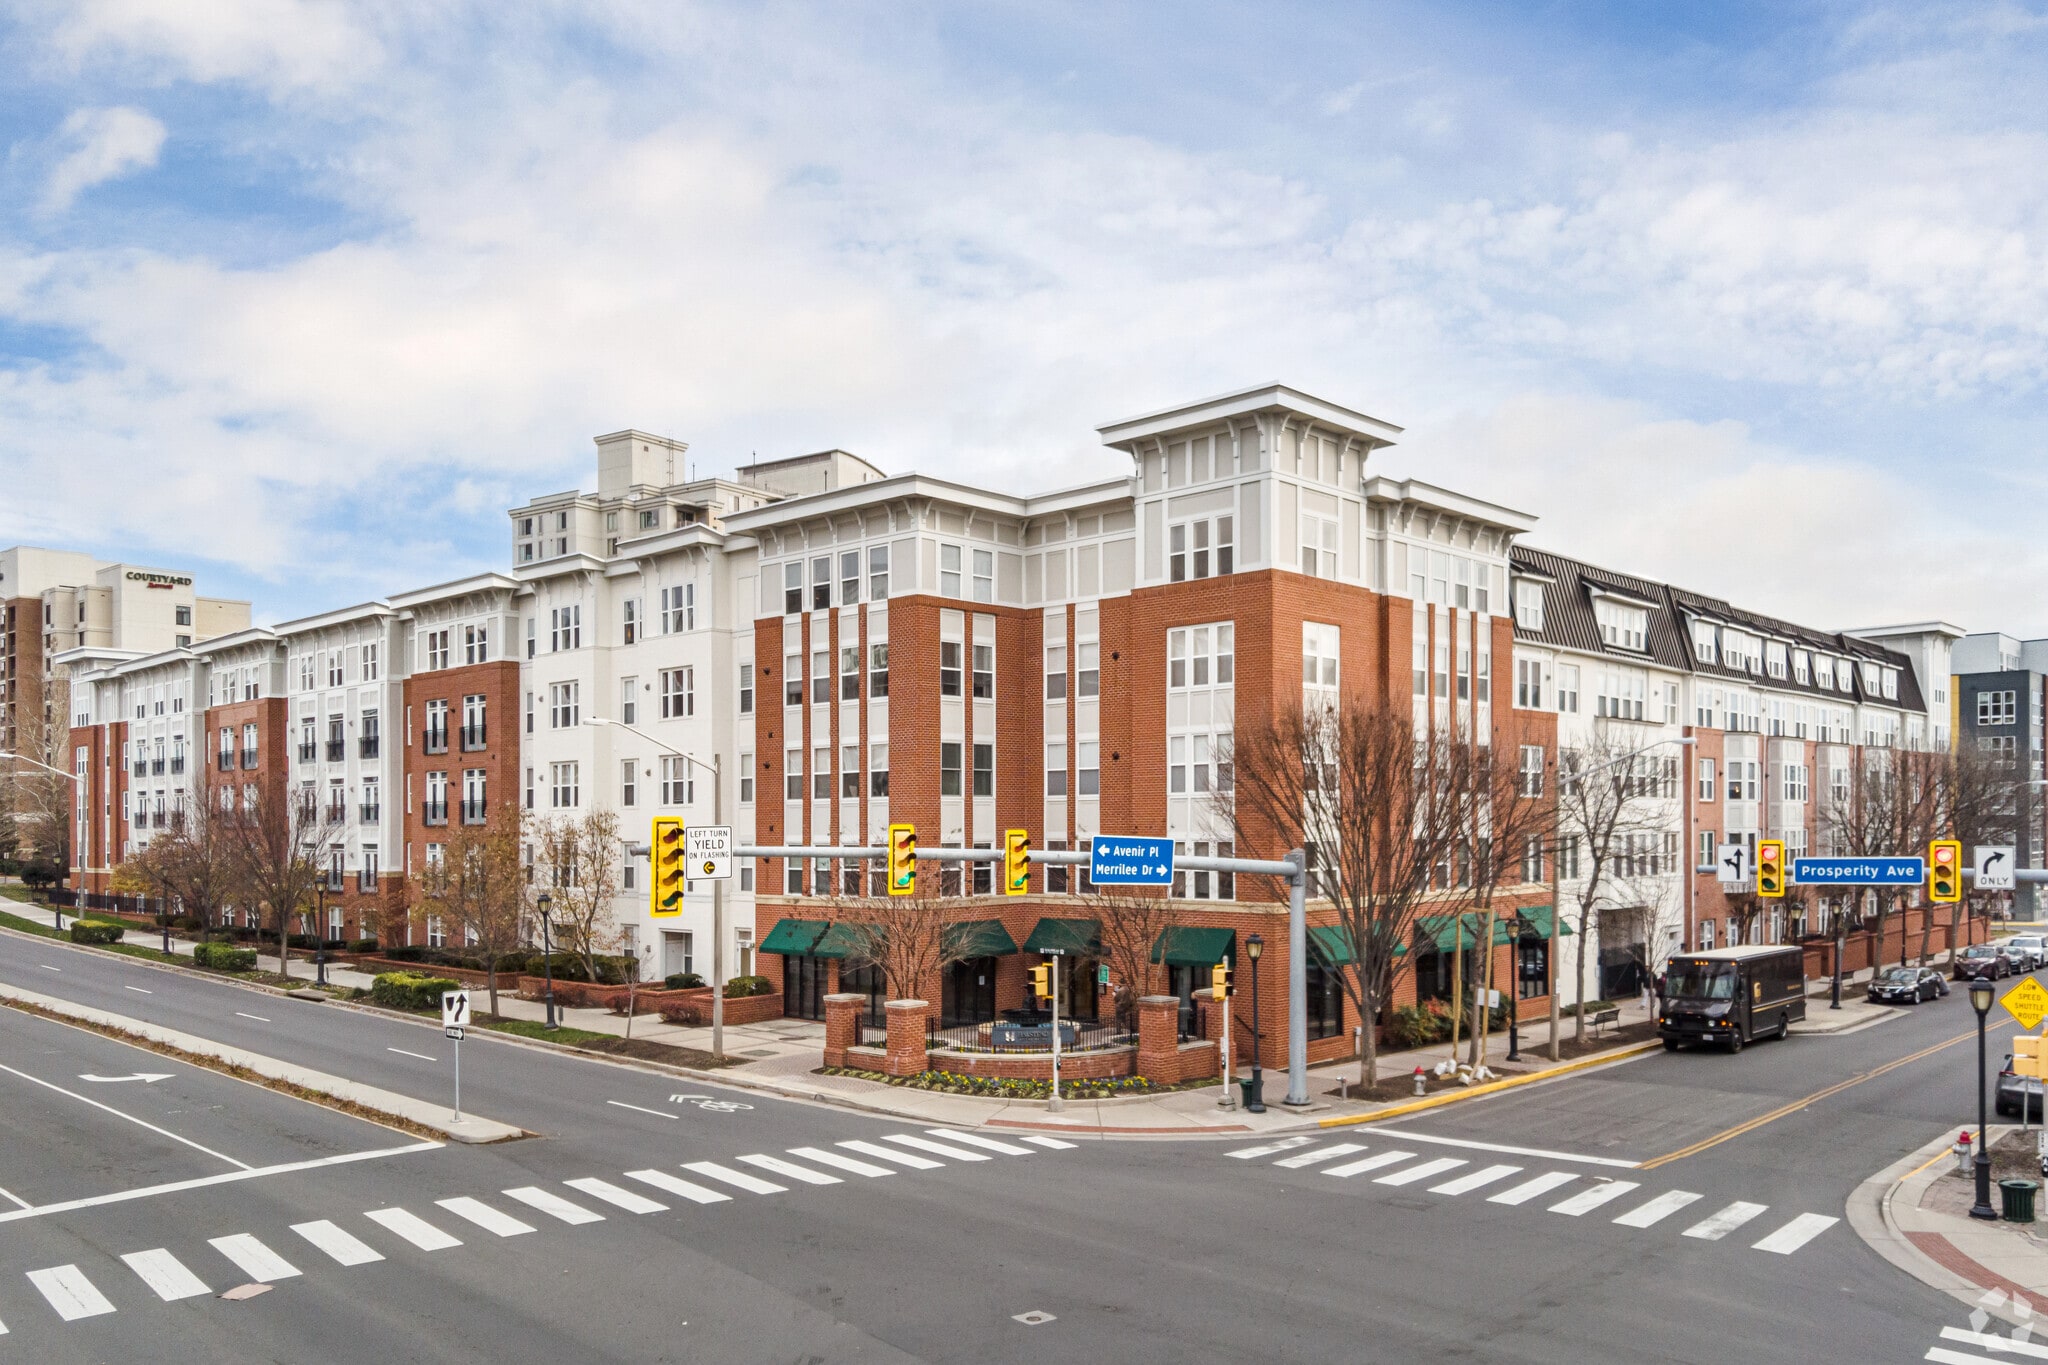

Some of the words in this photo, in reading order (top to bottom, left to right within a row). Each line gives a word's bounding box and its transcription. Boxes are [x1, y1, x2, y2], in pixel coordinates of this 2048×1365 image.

[126, 572, 192, 586] COURTYARD
[694, 840, 724, 850] YIELD
[1113, 845, 1145, 857] Avenir
[1149, 846, 1159, 858] Pl
[1096, 864, 1138, 876] Merrilee
[1142, 864, 1154, 876] Dr
[1802, 865, 1878, 878] Prosperity
[1886, 866, 1915, 876] Ave
[1980, 877, 2008, 885] ONLY
[2015, 1002, 2044, 1012] SHUTTLE
[2018, 1012, 2041, 1020] ROUTE
